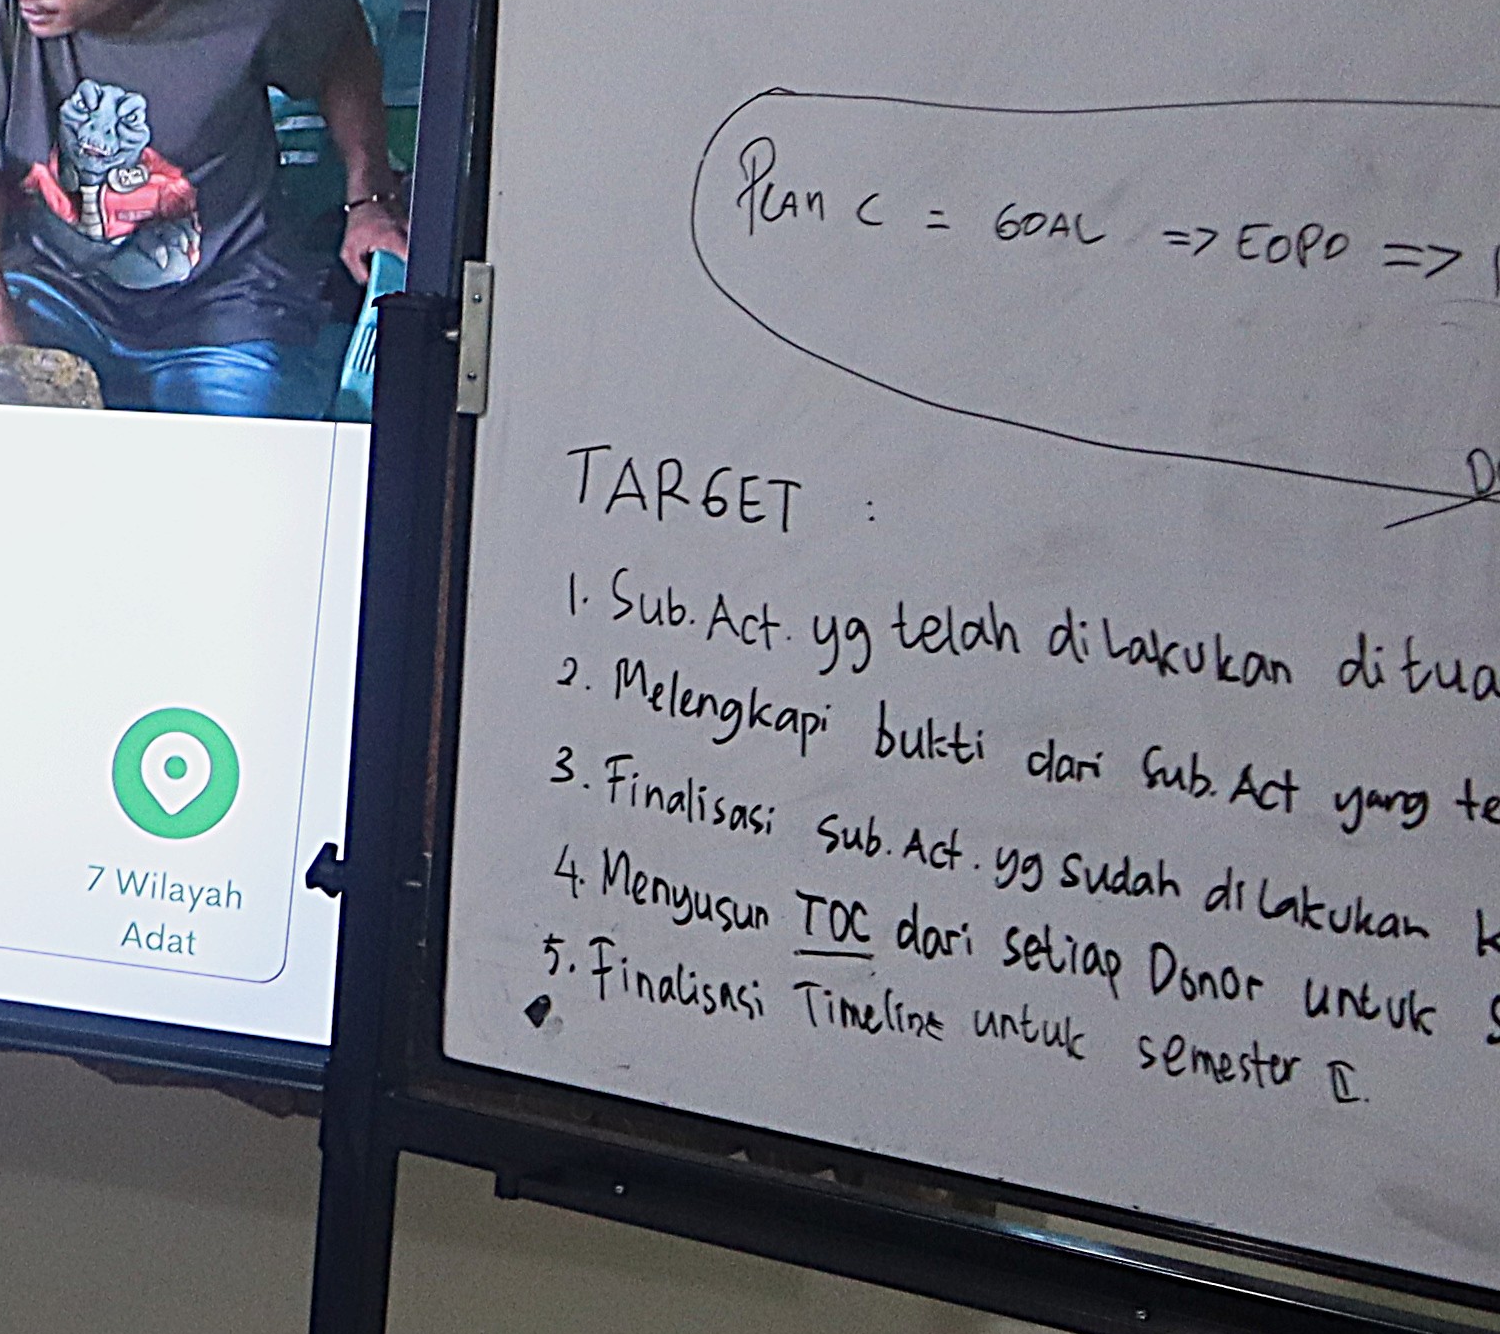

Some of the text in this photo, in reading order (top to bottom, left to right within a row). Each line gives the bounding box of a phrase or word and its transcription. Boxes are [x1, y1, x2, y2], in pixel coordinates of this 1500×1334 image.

[996, 202, 1107, 247] GOAL
[568, 443, 802, 535] TARGET
[813, 613, 871, 676] yg
[892, 600, 1021, 655] telah
[556, 658, 591, 691] 2.
[615, 657, 829, 757] Melengkapi
[875, 699, 986, 764] bukti
[1027, 739, 1103, 783] dari
[1333, 786, 1430, 835] yang
[550, 746, 591, 789] 3.
[604, 753, 776, 835] Finalisasi
[995, 846, 1043, 893] yg
[87, 865, 244, 913] 7 Wilayah
[120, 922, 197, 956] Adat
[554, 844, 586, 898] 4.
[601, 847, 769, 932] Menyusun
[795, 889, 871, 945] TOC
[897, 901, 973, 960] dari
[1002, 923, 1122, 1000] setiap
[1150, 941, 1264, 1003] Donor
[1305, 978, 1436, 1037] untuk
[975, 1003, 1087, 1061] untuk
[1140, 1032, 1301, 1088] semester
